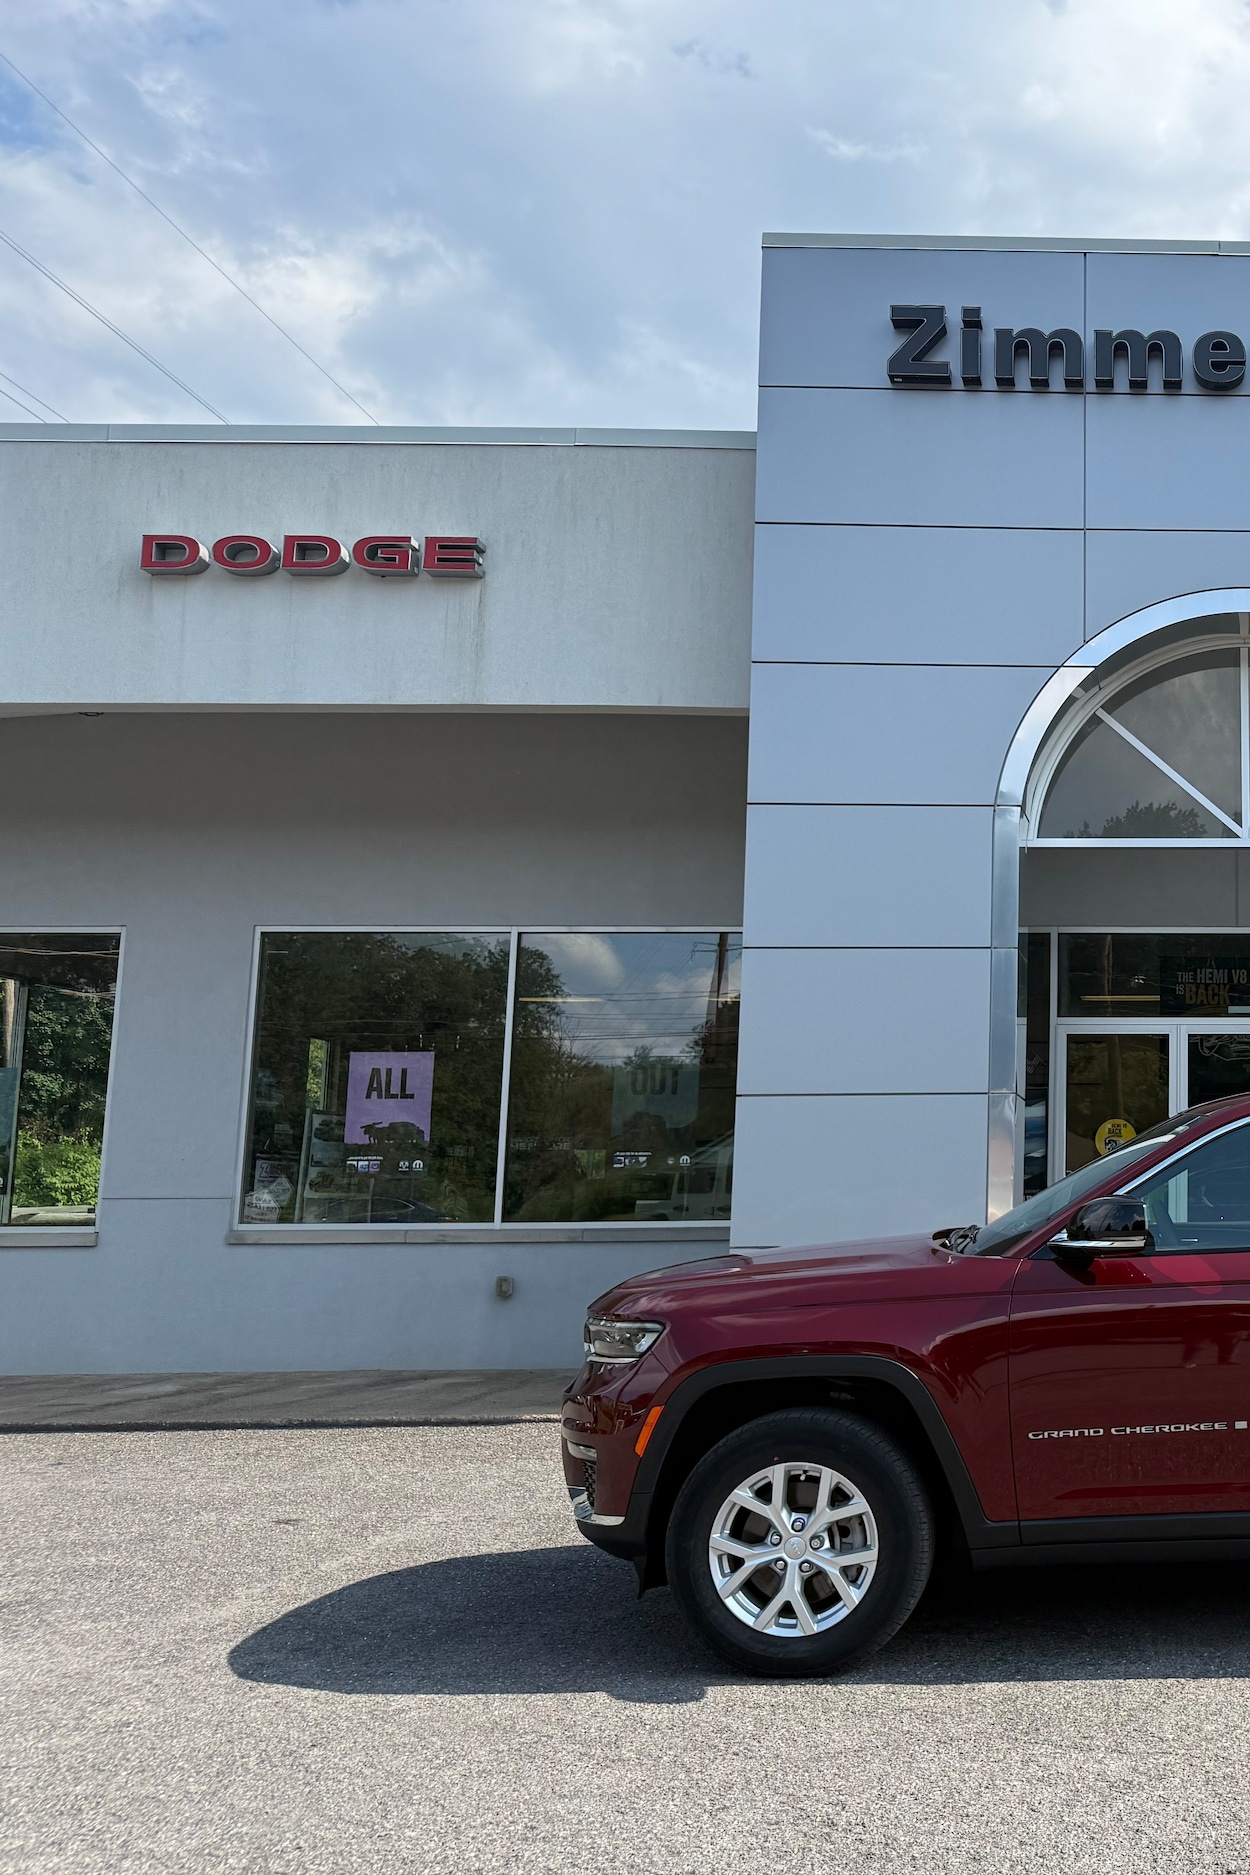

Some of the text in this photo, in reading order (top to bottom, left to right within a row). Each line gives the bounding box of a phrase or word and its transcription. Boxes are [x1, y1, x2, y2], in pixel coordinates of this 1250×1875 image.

[139, 534, 486, 578] DODGE
[1177, 968, 1248, 985] THE HEMI V8
[1175, 983, 1231, 1006] IS BACK
[365, 1067, 415, 1100] ALL
[630, 1063, 684, 1096] OUT
[1028, 1421, 1228, 1440] GRAND CHEROKEE
